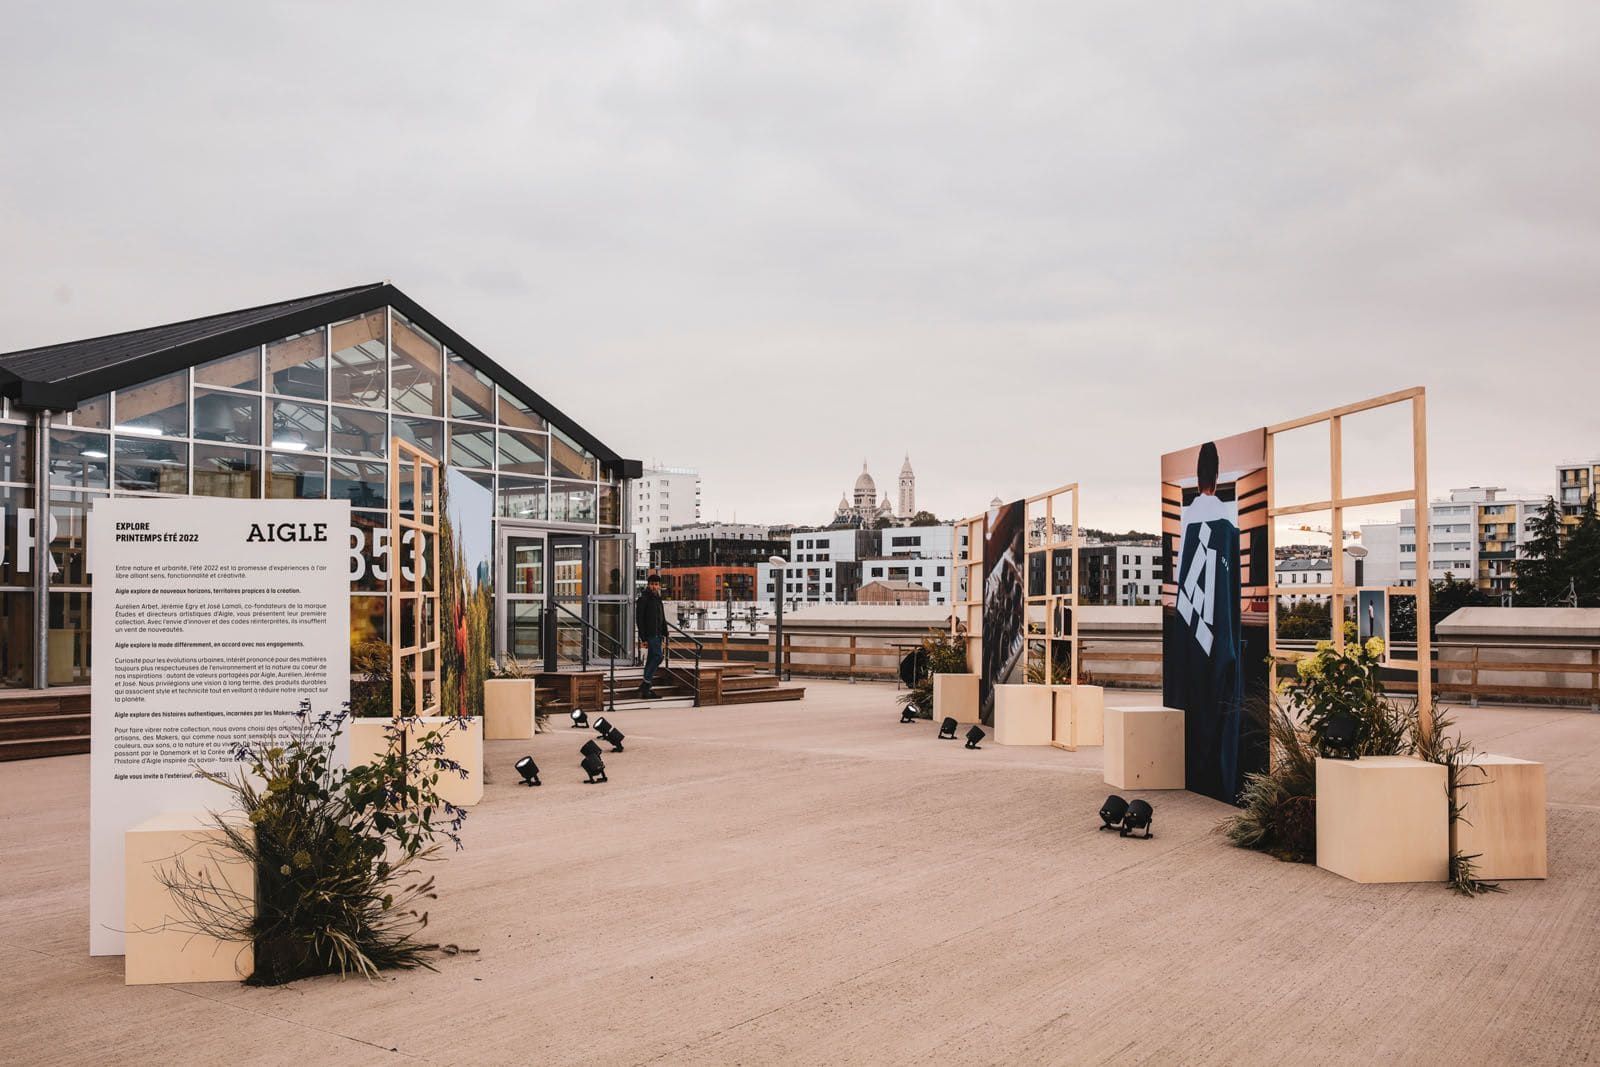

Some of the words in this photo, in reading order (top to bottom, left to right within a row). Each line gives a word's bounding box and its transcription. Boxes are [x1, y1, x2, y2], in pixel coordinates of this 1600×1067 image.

[115, 522, 150, 531] EXPLORE
[115, 533, 162, 542] PRINTEMPS
[163, 532, 178, 542] ÉTÉ
[179, 533, 199, 542] 2022
[246, 522, 328, 542] AIGLE
